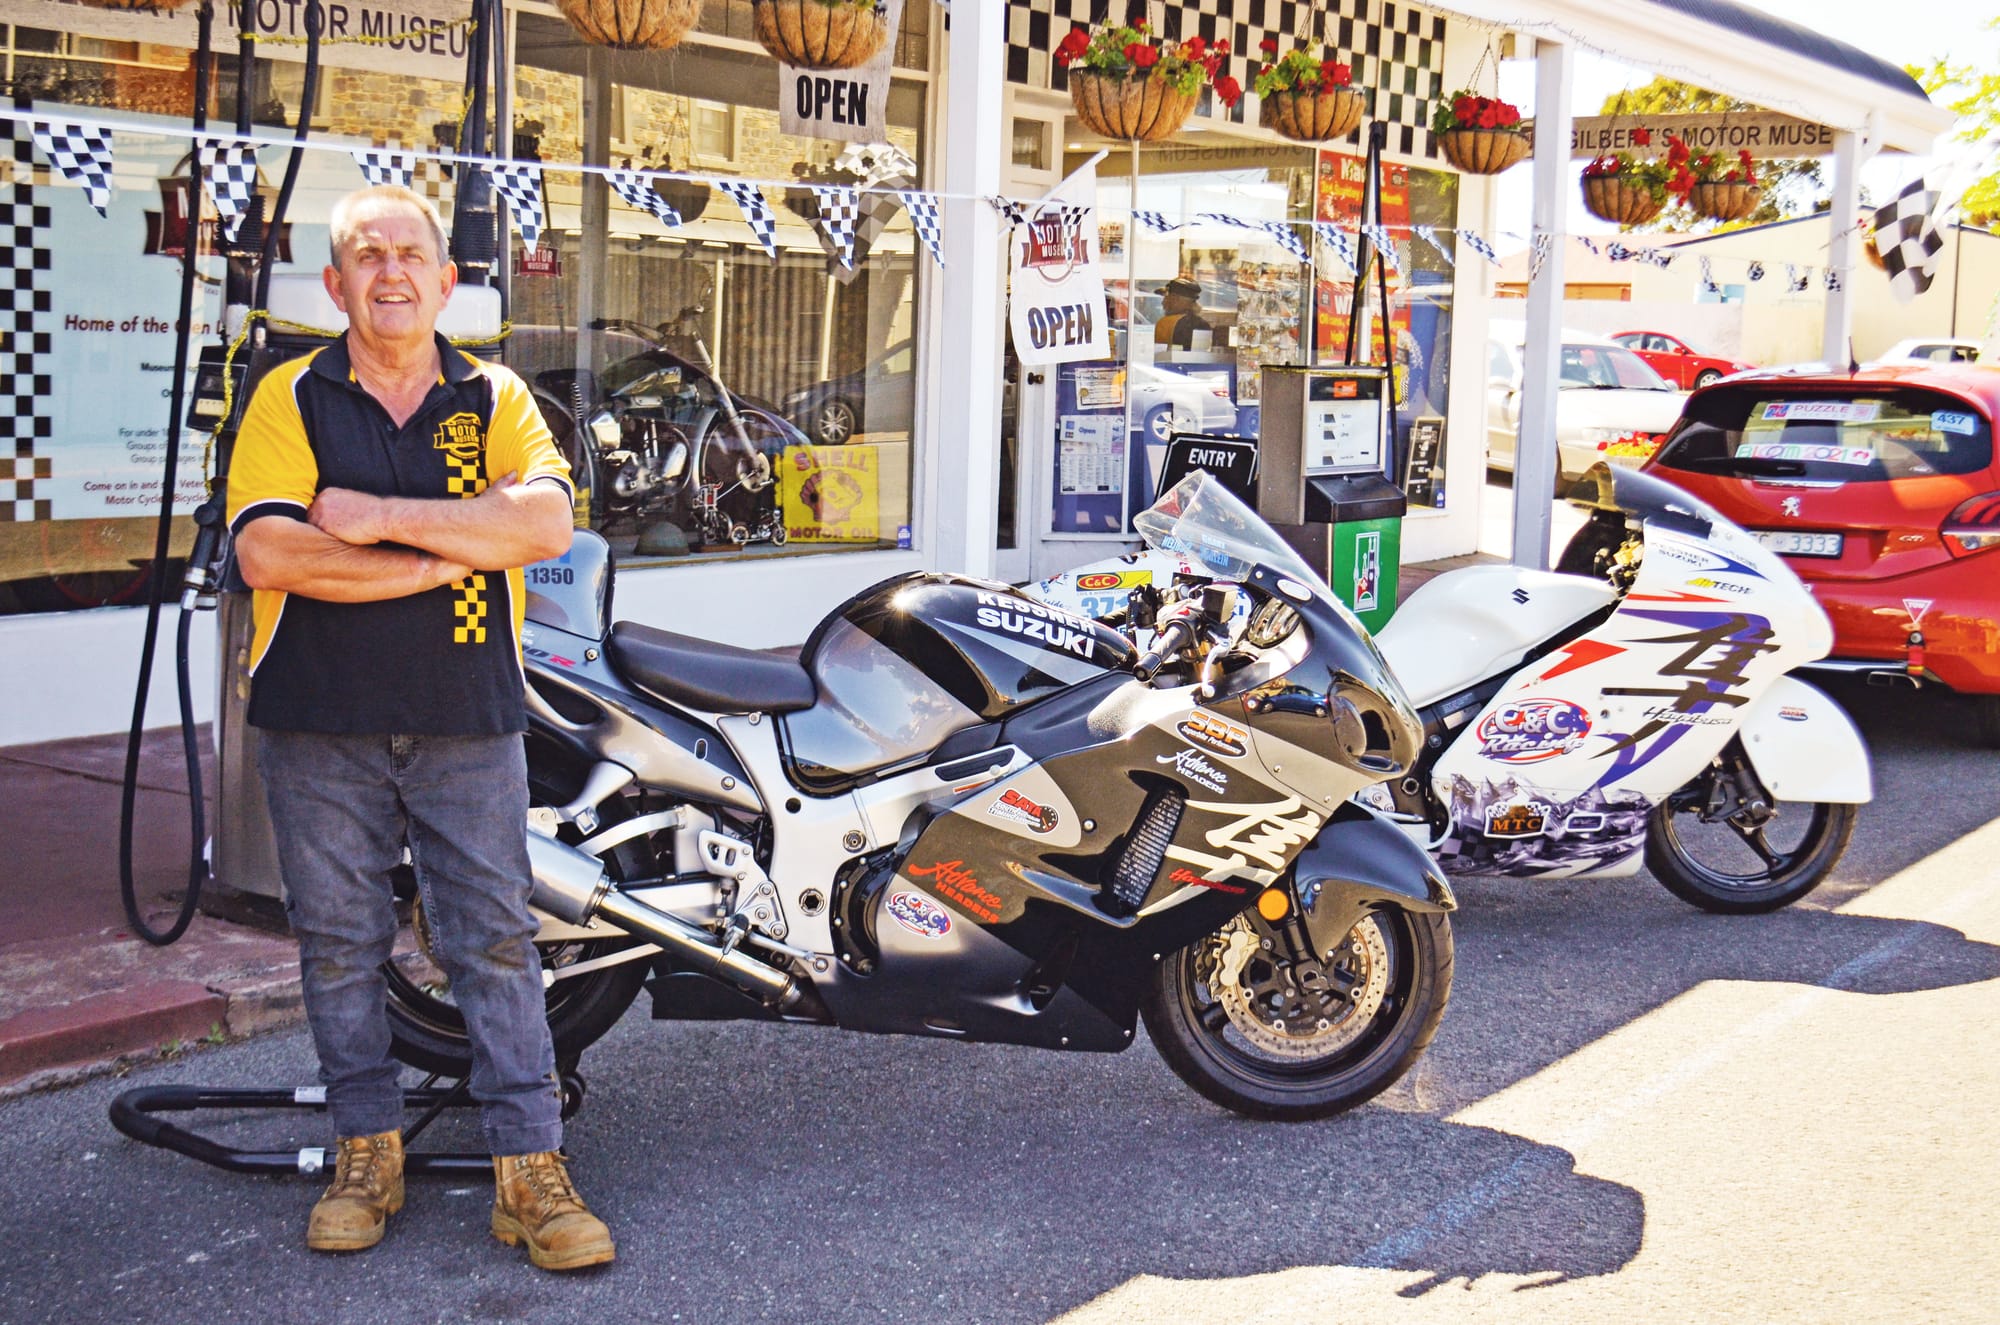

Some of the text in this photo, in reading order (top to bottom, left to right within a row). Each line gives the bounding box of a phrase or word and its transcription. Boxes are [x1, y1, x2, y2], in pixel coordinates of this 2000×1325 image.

[796, 74, 869, 127] OPEN
[1682, 125, 1761, 149] MOTOR
[64, 314, 115, 332] Home
[120, 315, 140, 333] of
[143, 316, 169, 334] the
[1027, 302, 1093, 350] OPEN
[1793, 403, 1850, 414] PUZZLE
[1937, 413, 1966, 425] 437
[793, 449, 869, 473] SHELL
[1188, 447, 1237, 468] ENTRY
[83, 481, 111, 492] Come
[105, 494, 137, 505] Motor
[790, 526, 876, 539] MOTOR OIL
[1788, 534, 1840, 554] 3333
[1658, 548, 1703, 568] SUZUKI
[1085, 576, 1112, 587] C&C
[976, 591, 1097, 637] KESSNER
[976, 607, 1095, 659] SUZUKI
[1187, 710, 1249, 744] SBP
[1494, 703, 1572, 735] C&C
[1480, 731, 1586, 757] Racing
[1156, 748, 1229, 784] Advance
[1175, 764, 1226, 795] HEADERS
[999, 788, 1043, 819] SATA
[1492, 817, 1542, 832] MTC
[907, 860, 1004, 909] Advance
[904, 892, 945, 928] C&C
[935, 881, 1000, 925] HEADERS
